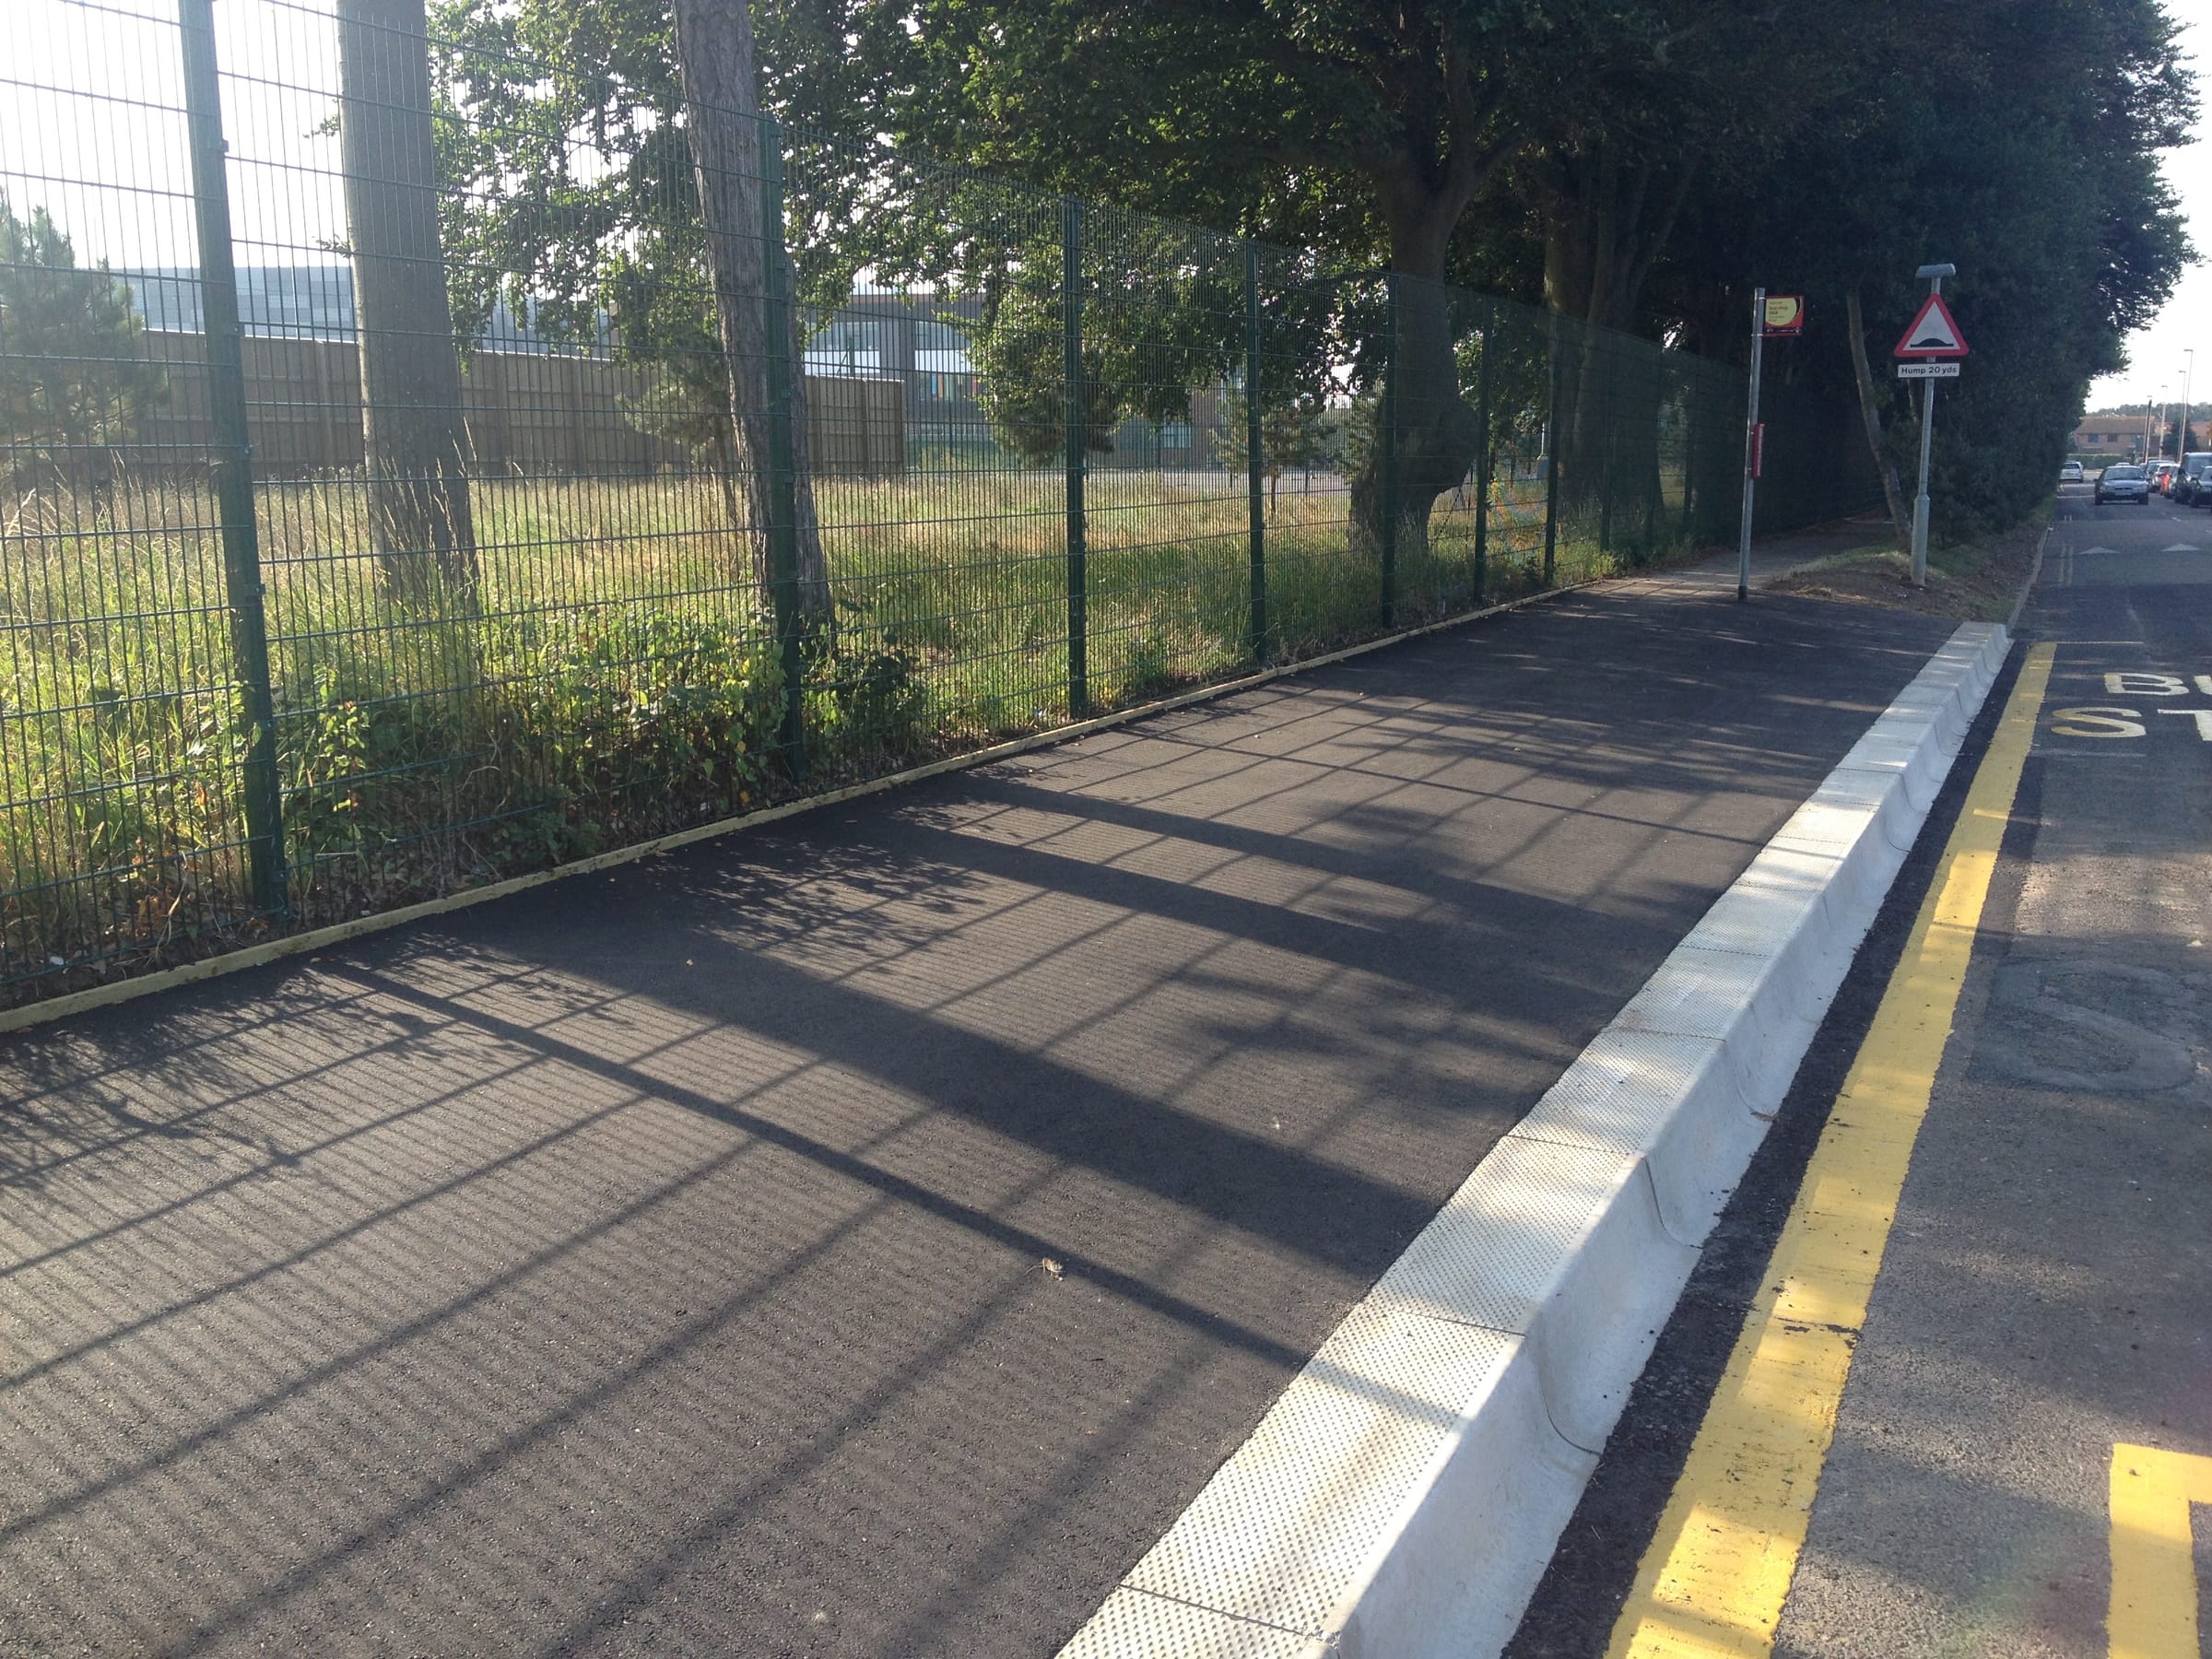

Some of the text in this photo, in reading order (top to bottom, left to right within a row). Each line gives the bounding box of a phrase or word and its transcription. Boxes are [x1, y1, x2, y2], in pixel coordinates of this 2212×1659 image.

[1901, 366, 1957, 375] Hump 20 yds
[2103, 672, 2212, 696] B
